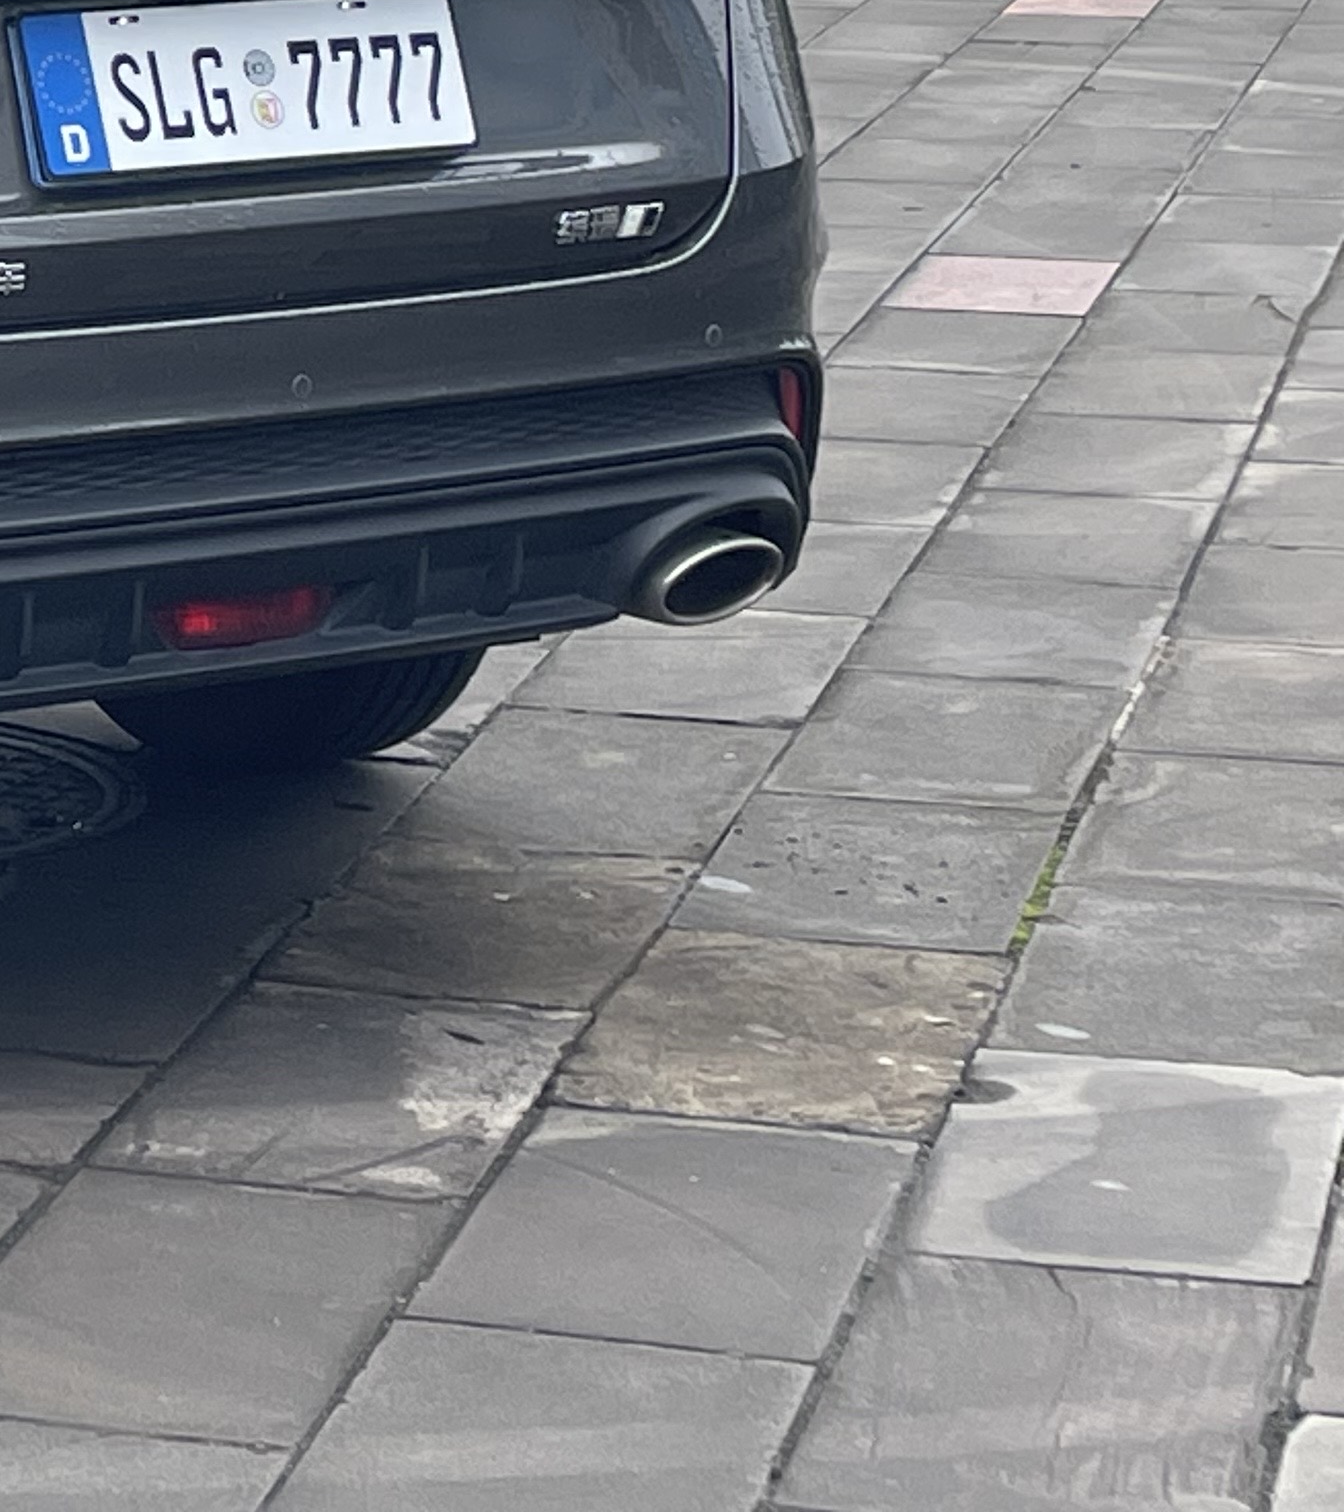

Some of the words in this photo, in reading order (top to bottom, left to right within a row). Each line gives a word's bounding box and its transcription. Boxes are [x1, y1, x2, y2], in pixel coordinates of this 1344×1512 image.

[110, 46, 238, 143] SLG
[286, 31, 442, 131] 7777
[60, 124, 91, 164] D
